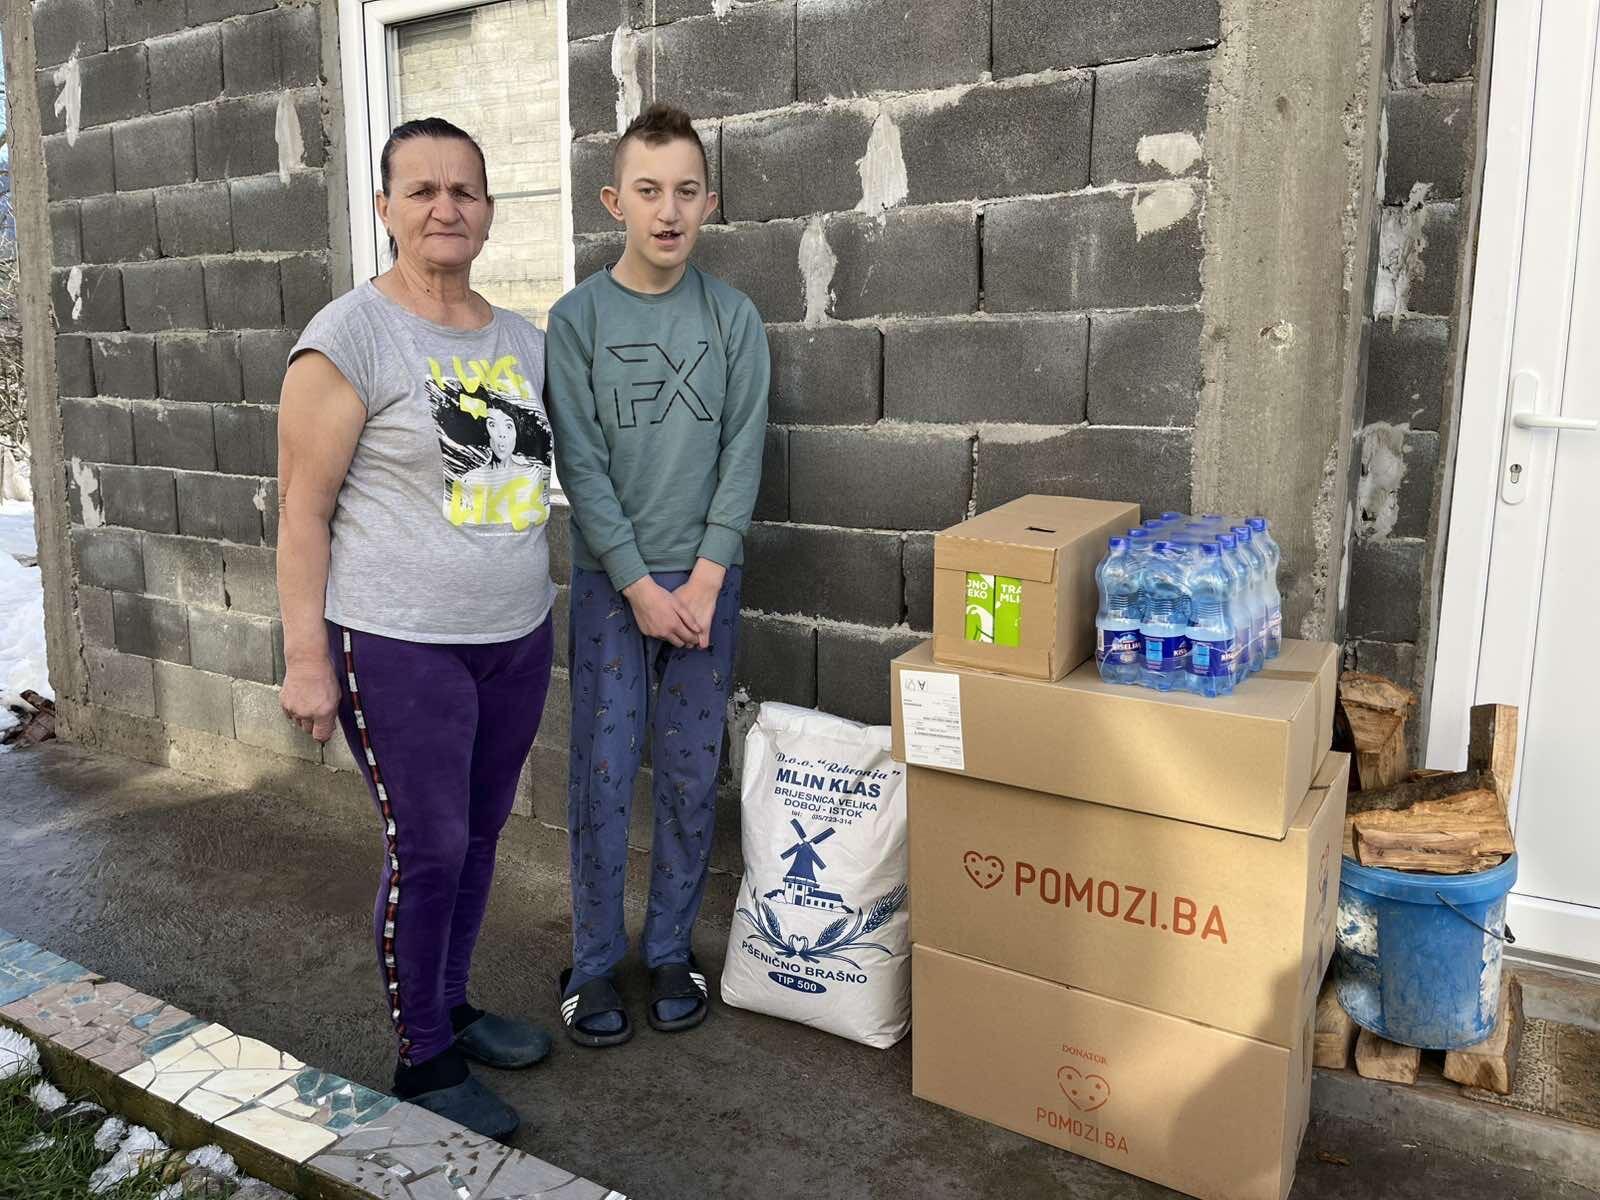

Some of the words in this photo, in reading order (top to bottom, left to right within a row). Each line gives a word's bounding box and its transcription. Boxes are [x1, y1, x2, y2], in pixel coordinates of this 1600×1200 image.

[776, 768, 825, 790] MLIN
[829, 778, 881, 798] KLAS
[774, 787, 835, 805] BRIJESNICA
[838, 798, 878, 811] VELIKA
[784, 798, 821, 812] DOBOJ
[829, 805, 863, 818] ISTOK
[1015, 861, 1228, 945] POMOZI.BA
[741, 940, 800, 973] PŠENIČNO
[805, 967, 868, 984] BRAŠNO
[777, 973, 794, 985] TIP
[797, 980, 817, 992] 500
[1062, 1044, 1108, 1065] DONATOR
[1036, 1106, 1129, 1154] POMOZI.BA
